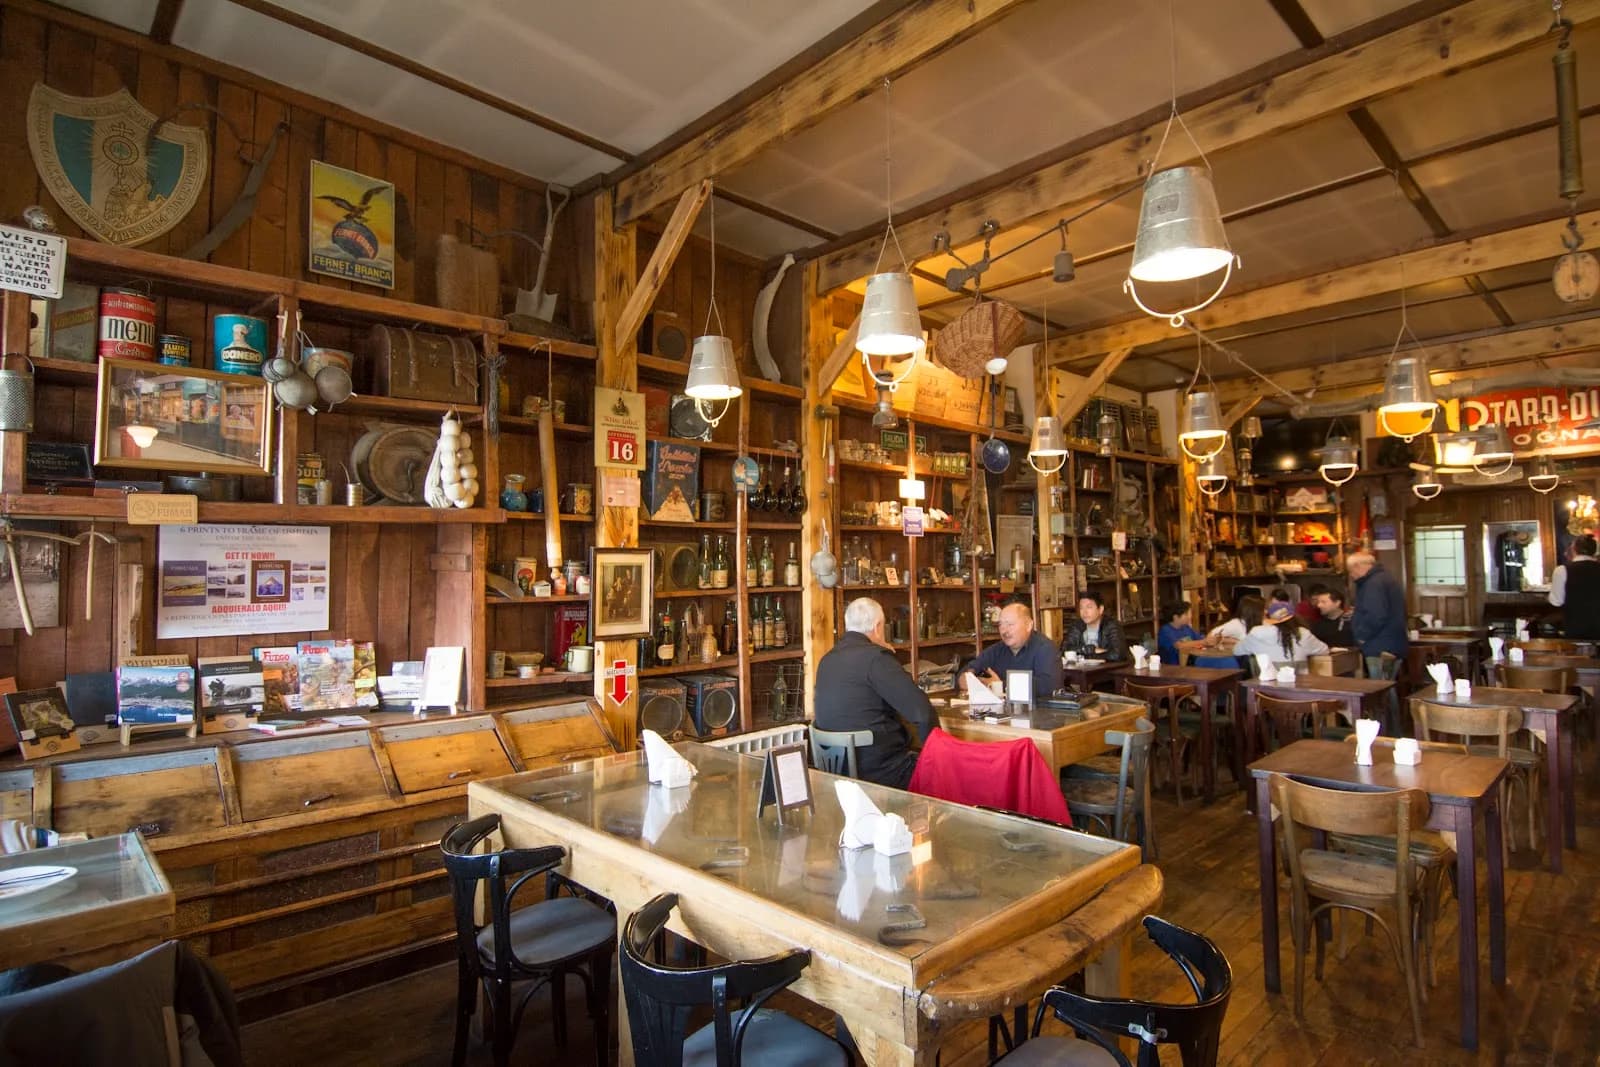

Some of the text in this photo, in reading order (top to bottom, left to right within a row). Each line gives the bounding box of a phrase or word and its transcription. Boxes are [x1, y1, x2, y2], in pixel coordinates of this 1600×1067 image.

[1, 231, 48, 247] VISO
[2, 254, 50, 270] LA VENTA
[15, 250, 50, 262] CLIENTES
[4, 262, 49, 277] NAFTA
[612, 440, 634, 461] 16
[225, 552, 276, 560] GET IT NOW!!
